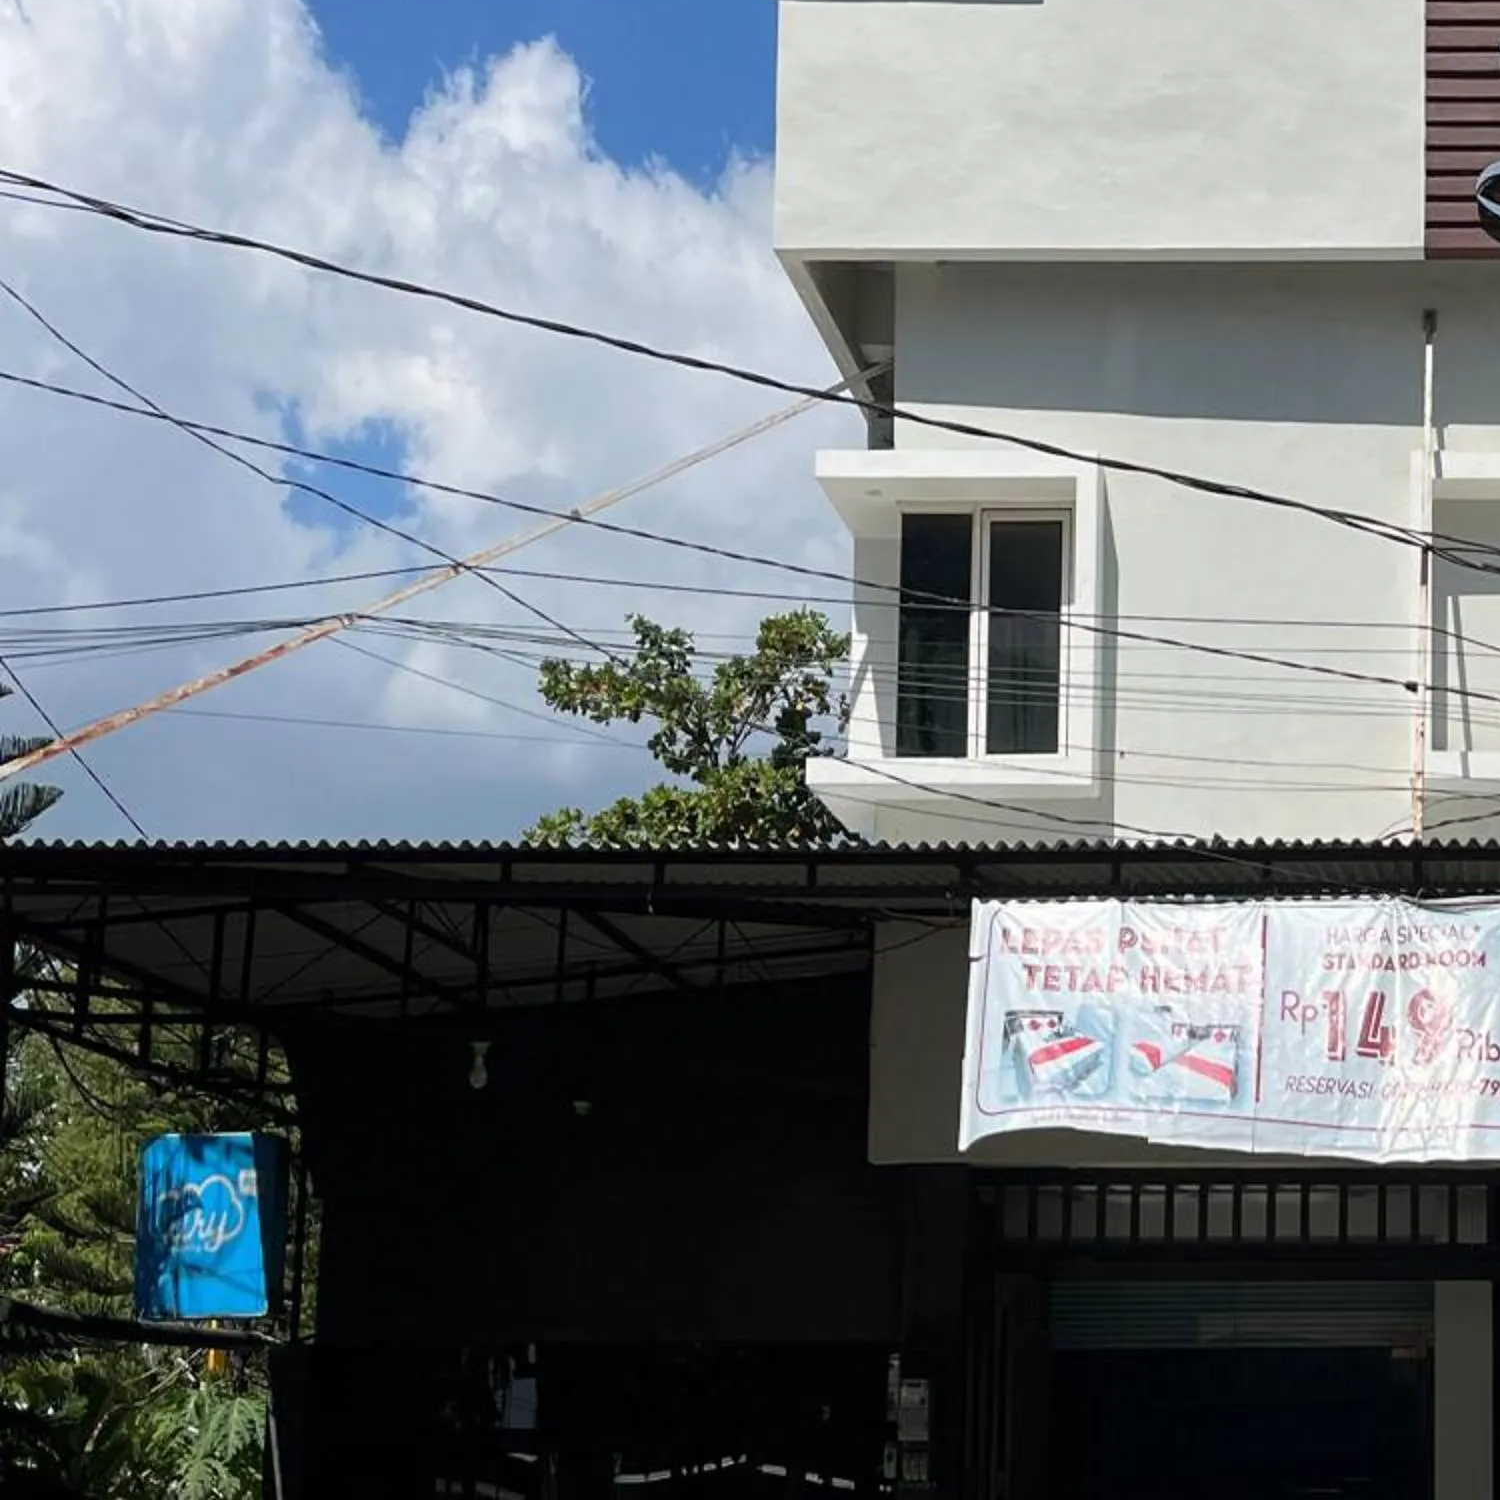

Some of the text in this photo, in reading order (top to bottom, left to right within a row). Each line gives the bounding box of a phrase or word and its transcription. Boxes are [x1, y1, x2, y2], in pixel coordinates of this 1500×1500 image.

[1022, 963, 1252, 993] TETAP HEMAT
[1322, 988, 1453, 1066] 149
[1285, 1075, 1374, 1099] RESERVASI
